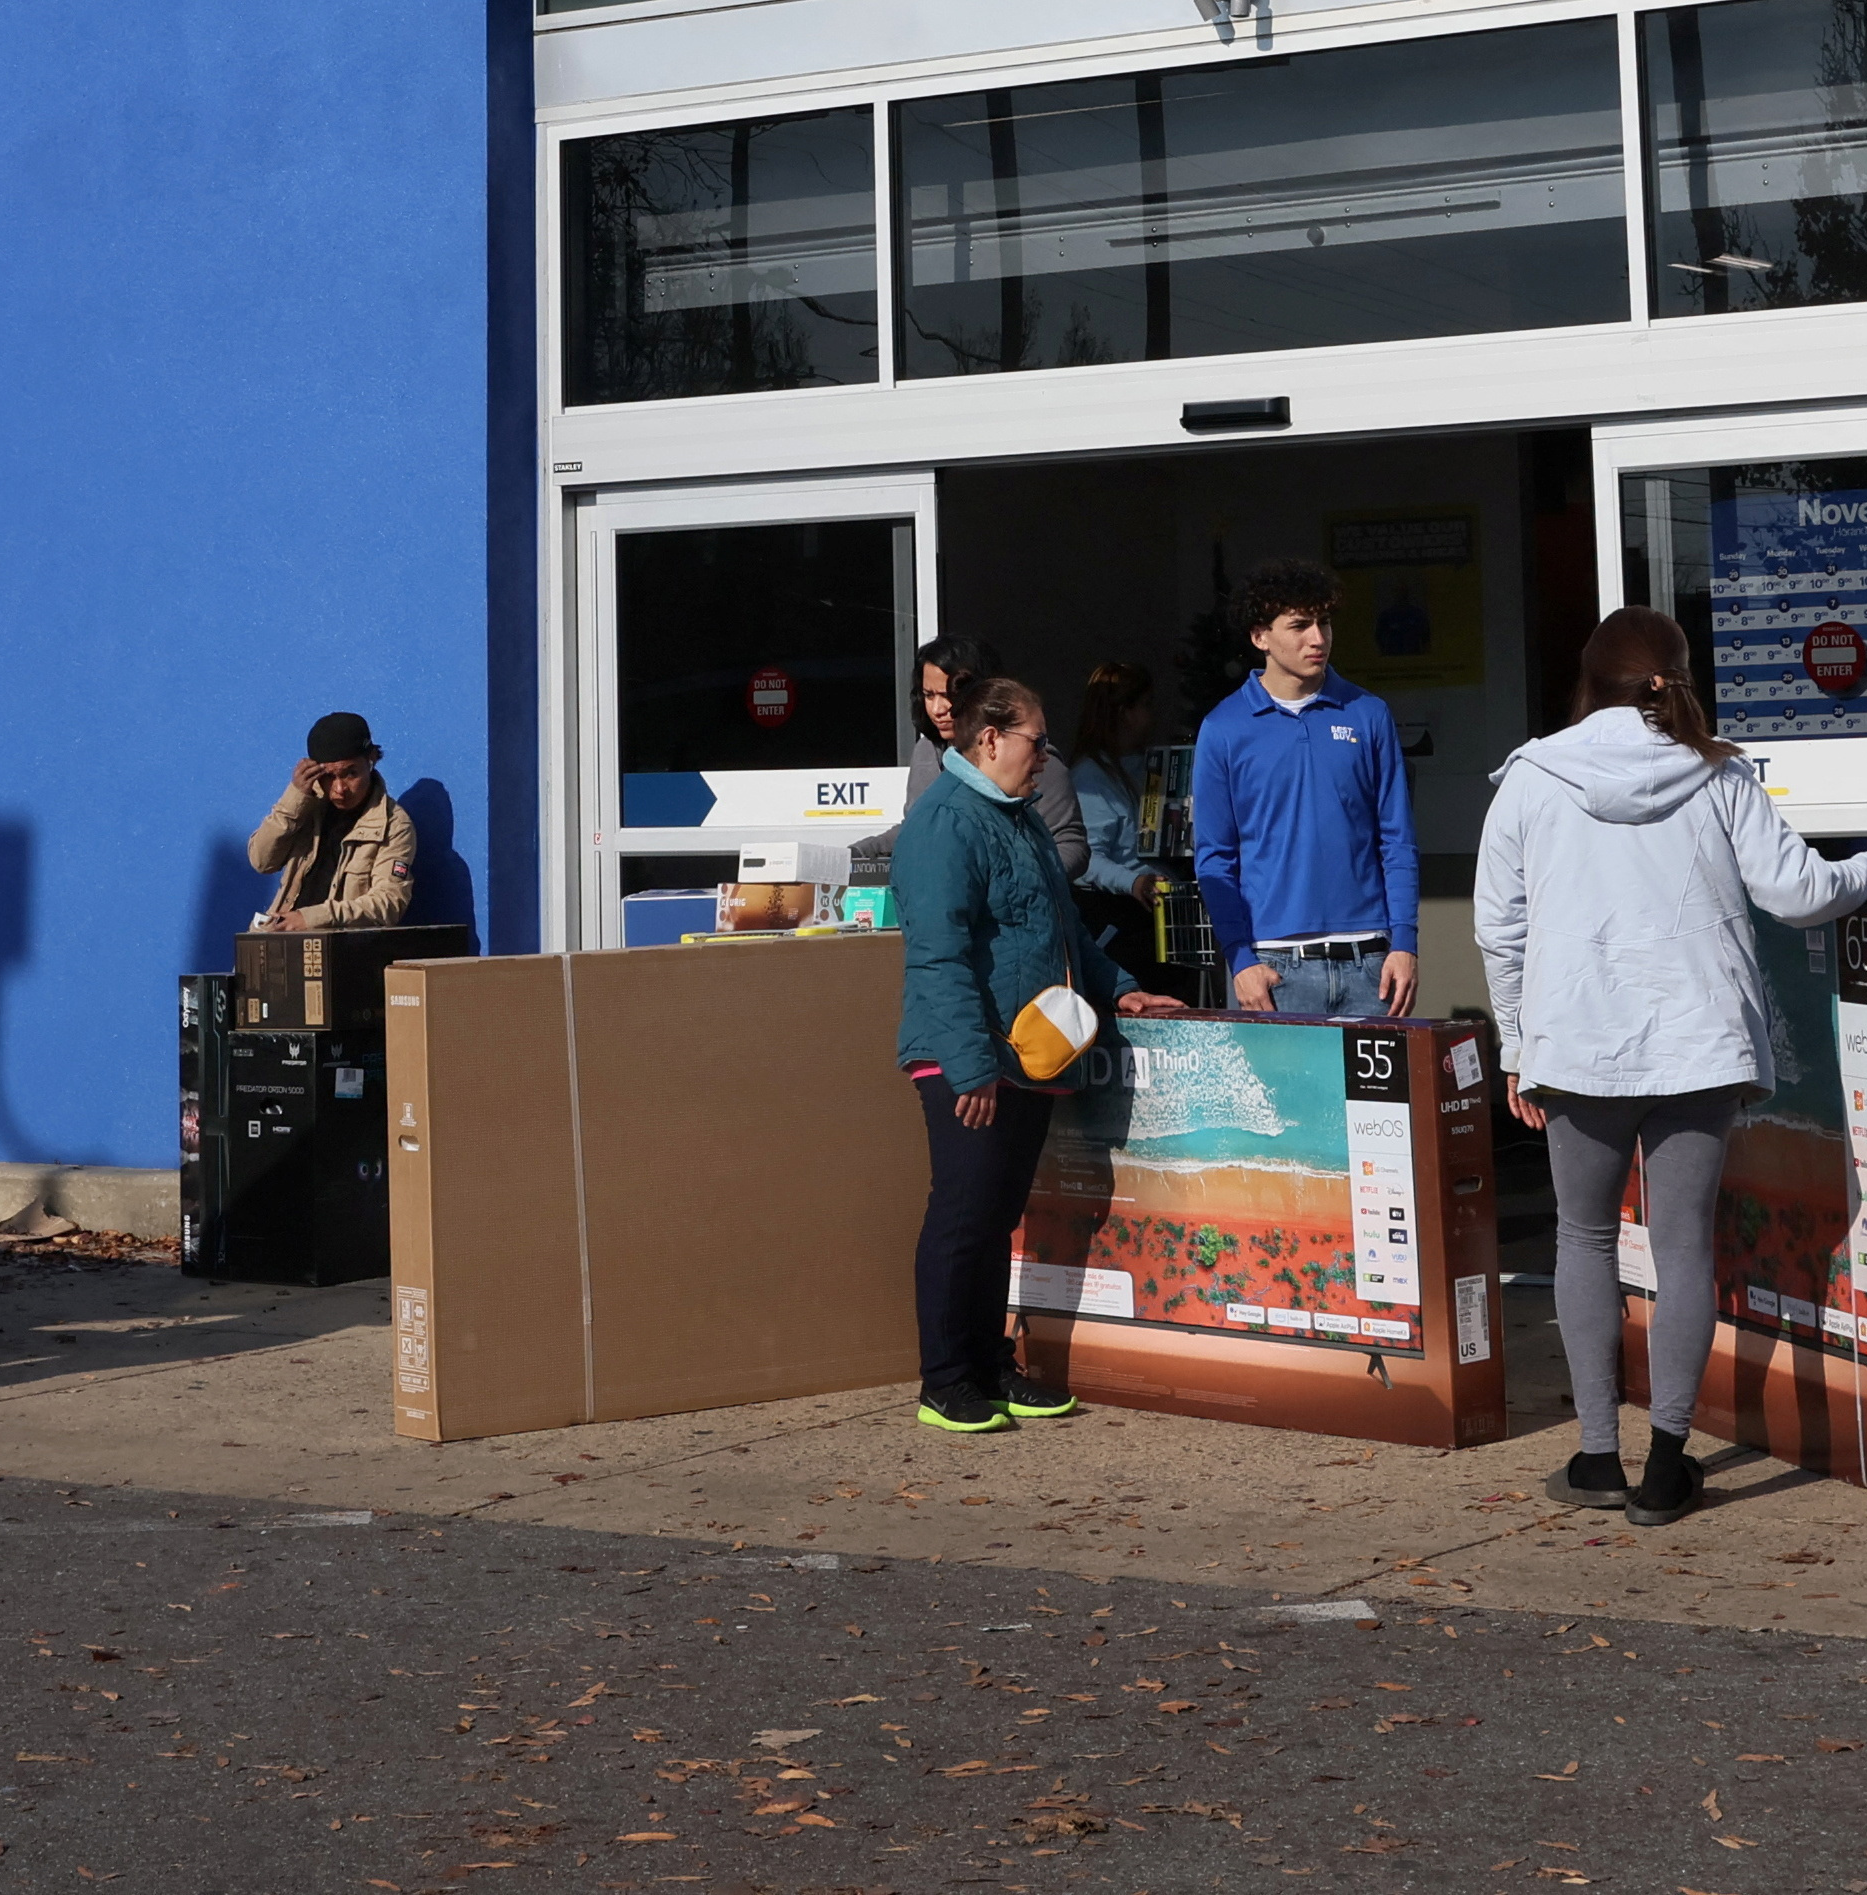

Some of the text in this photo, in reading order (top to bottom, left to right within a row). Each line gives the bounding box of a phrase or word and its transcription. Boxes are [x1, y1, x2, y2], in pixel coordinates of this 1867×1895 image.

[554, 463, 582, 472] STANLEY
[1766, 549, 1797, 558] Monday
[1816, 547, 1846, 556] Tuesday
[1812, 635, 1854, 646] DO NOT
[1817, 665, 1853, 676] ENTER
[754, 679, 787, 689] DO NOT
[757, 706, 785, 716] ENTER
[1330, 725, 1354, 735] BEST
[1333, 732, 1350, 741] BUY
[816, 782, 870, 805] EXIT
[390, 995, 420, 1007] SAMSUNG
[1152, 1048, 1201, 1071] ThinQ
[1357, 1039, 1396, 1080] 55"
[236, 1084, 305, 1095] PREDATOR ORION 5000
[1441, 1103, 1460, 1113] UHD
[1354, 1119, 1404, 1138] webOS
[1451, 1124, 1475, 1135] 55UQ70
[183, 1214, 191, 1262] SAMSUNG
[1460, 1343, 1477, 1358] US
